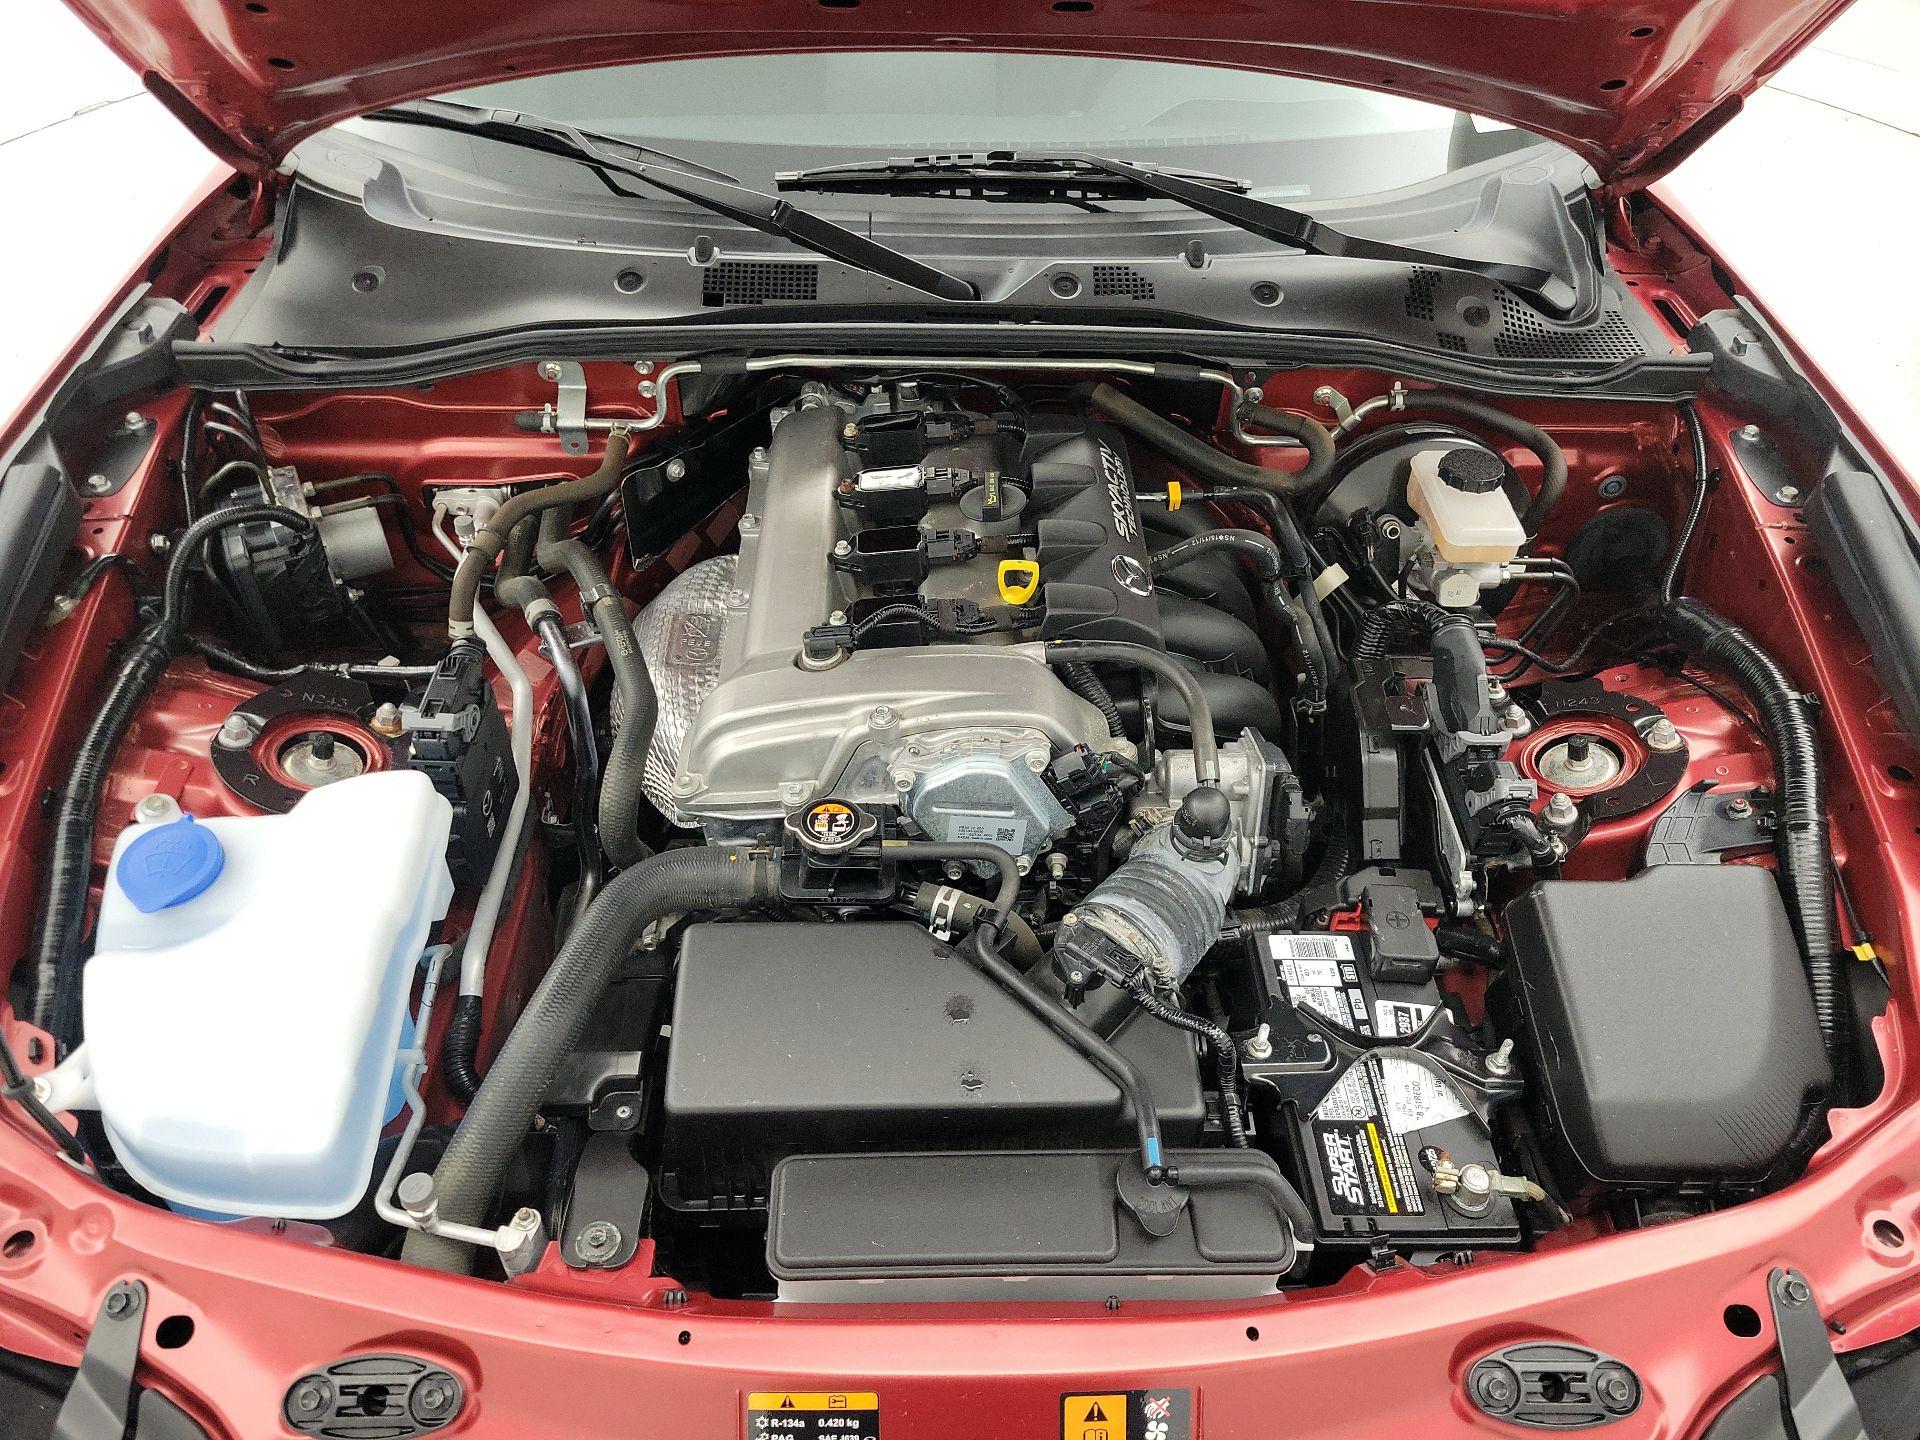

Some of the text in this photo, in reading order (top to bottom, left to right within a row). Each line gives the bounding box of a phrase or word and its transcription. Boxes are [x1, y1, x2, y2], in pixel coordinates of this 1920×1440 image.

[1098, 437, 1130, 543] SKYACTIV
[1113, 451, 1138, 538] TECHNOLOGY
[243, 773, 260, 786] R
[1354, 997, 1363, 1010] Pb
[1323, 1132, 1343, 1196] SUPER
[1334, 1131, 1365, 1206] START
[770, 1418, 860, 1429] R-134a 0.420 kg
